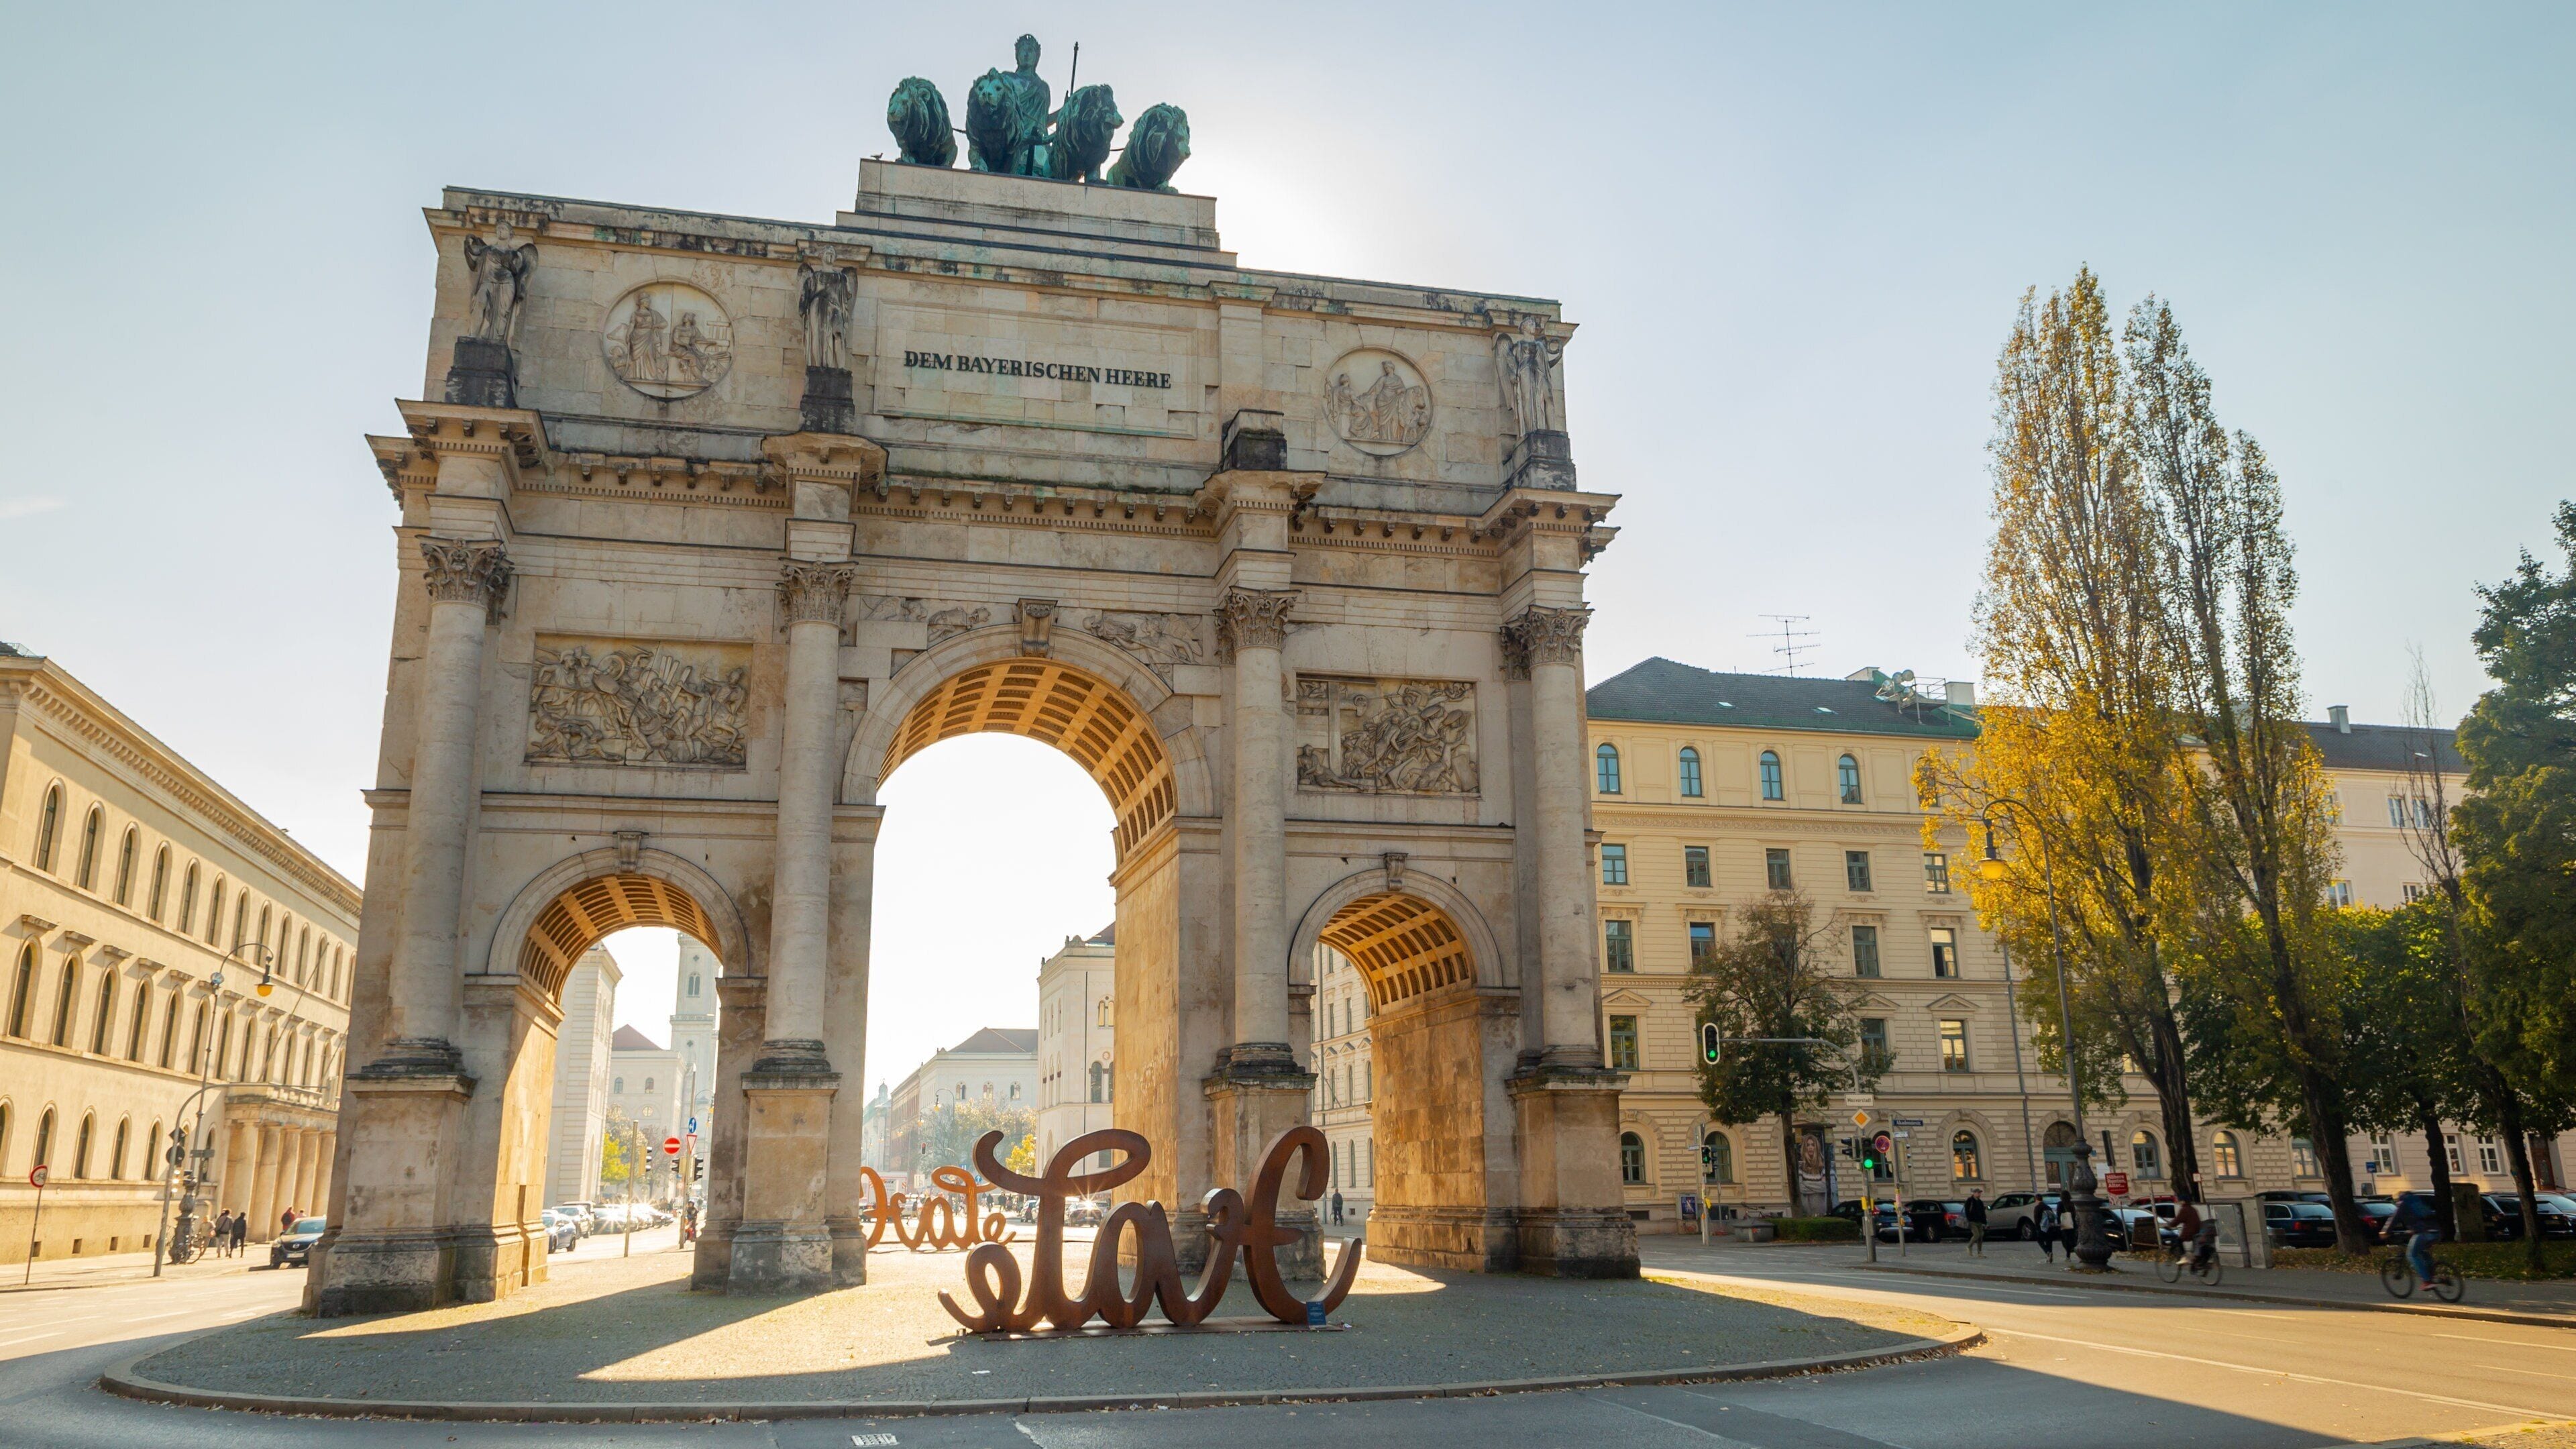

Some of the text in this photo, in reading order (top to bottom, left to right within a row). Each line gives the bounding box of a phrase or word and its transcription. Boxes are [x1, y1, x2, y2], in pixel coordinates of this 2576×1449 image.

[904, 351, 1171, 388] DEM BAYERISCHEN HEERE
